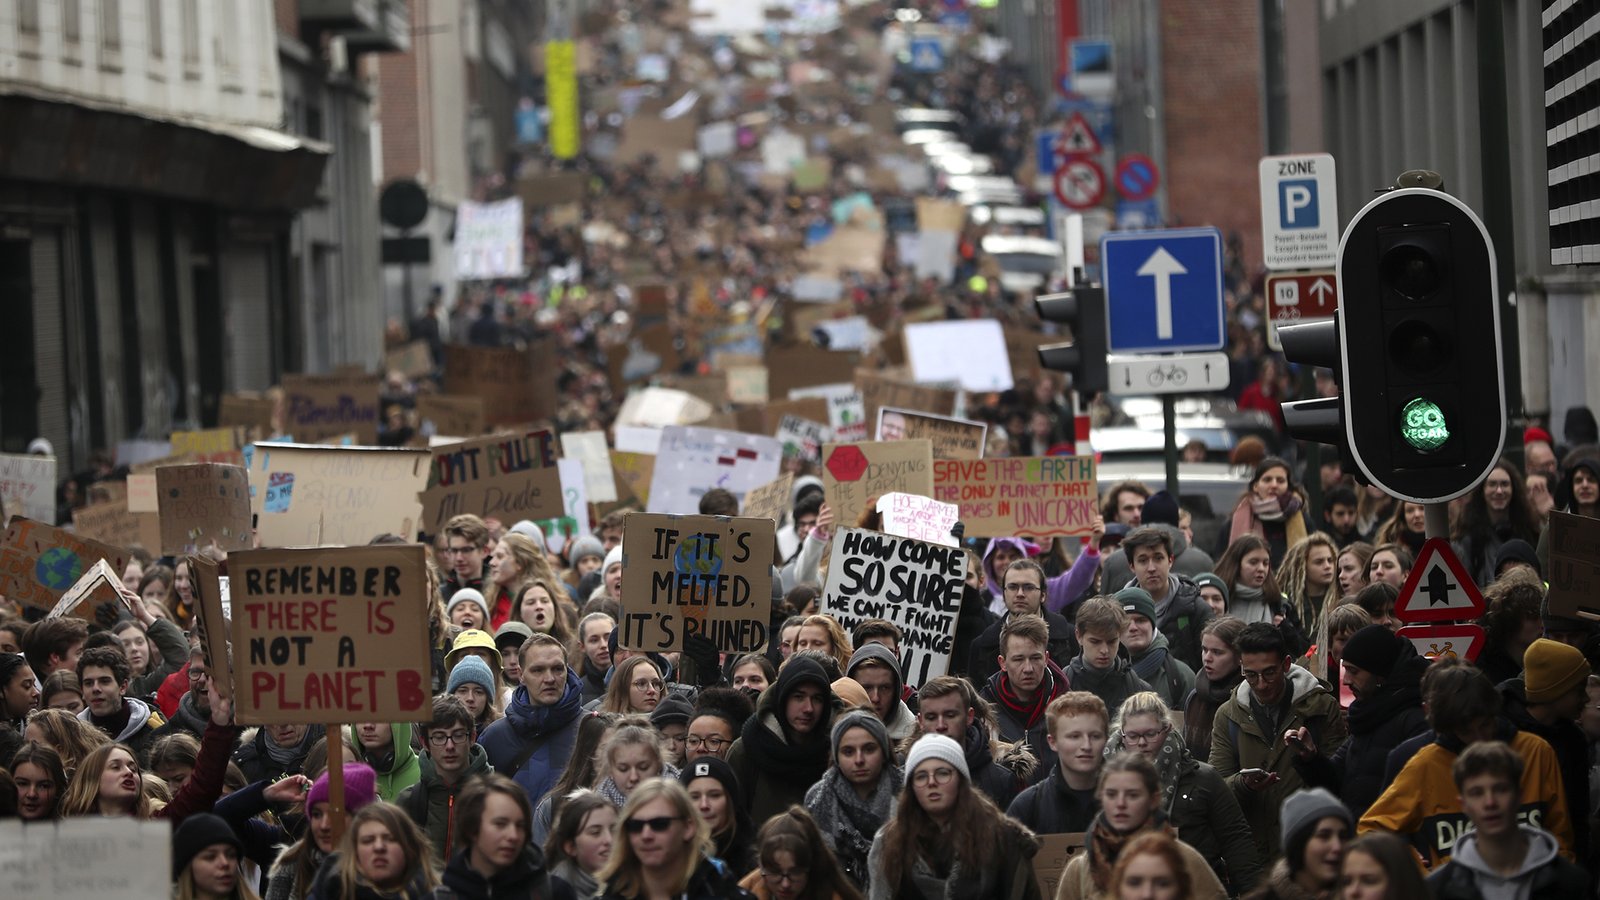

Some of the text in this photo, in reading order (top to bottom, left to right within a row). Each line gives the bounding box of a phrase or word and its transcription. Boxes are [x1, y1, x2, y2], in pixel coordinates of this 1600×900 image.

[1278, 160, 1316, 175] ZONE
[1286, 185, 1311, 224] P
[1280, 288, 1294, 299] 10
[1402, 428, 1448, 439] VEGAN
[1406, 409, 1442, 427] GO
[487, 430, 555, 477] POLLUTE
[868, 461, 926, 484] DENYING
[832, 481, 855, 501] THE
[961, 484, 996, 500] ONLY
[1053, 482, 1091, 496] THAT
[998, 500, 1010, 517] IN
[1015, 497, 1097, 528] UNICORNS
[652, 528, 679, 559] IF
[842, 533, 964, 577] HOW COME
[246, 566, 401, 597] REMEMBER
[651, 571, 755, 608] MELTED,
[839, 557, 965, 612] SO SURE
[244, 600, 395, 634] THERE IS
[827, 593, 953, 634] WE CAN'T FIGHT
[624, 612, 766, 652] IT'S RUINED
[897, 625, 953, 655] HANGE
[250, 636, 312, 667] NOT
[337, 636, 355, 668] A
[252, 670, 426, 712] PLANET B
